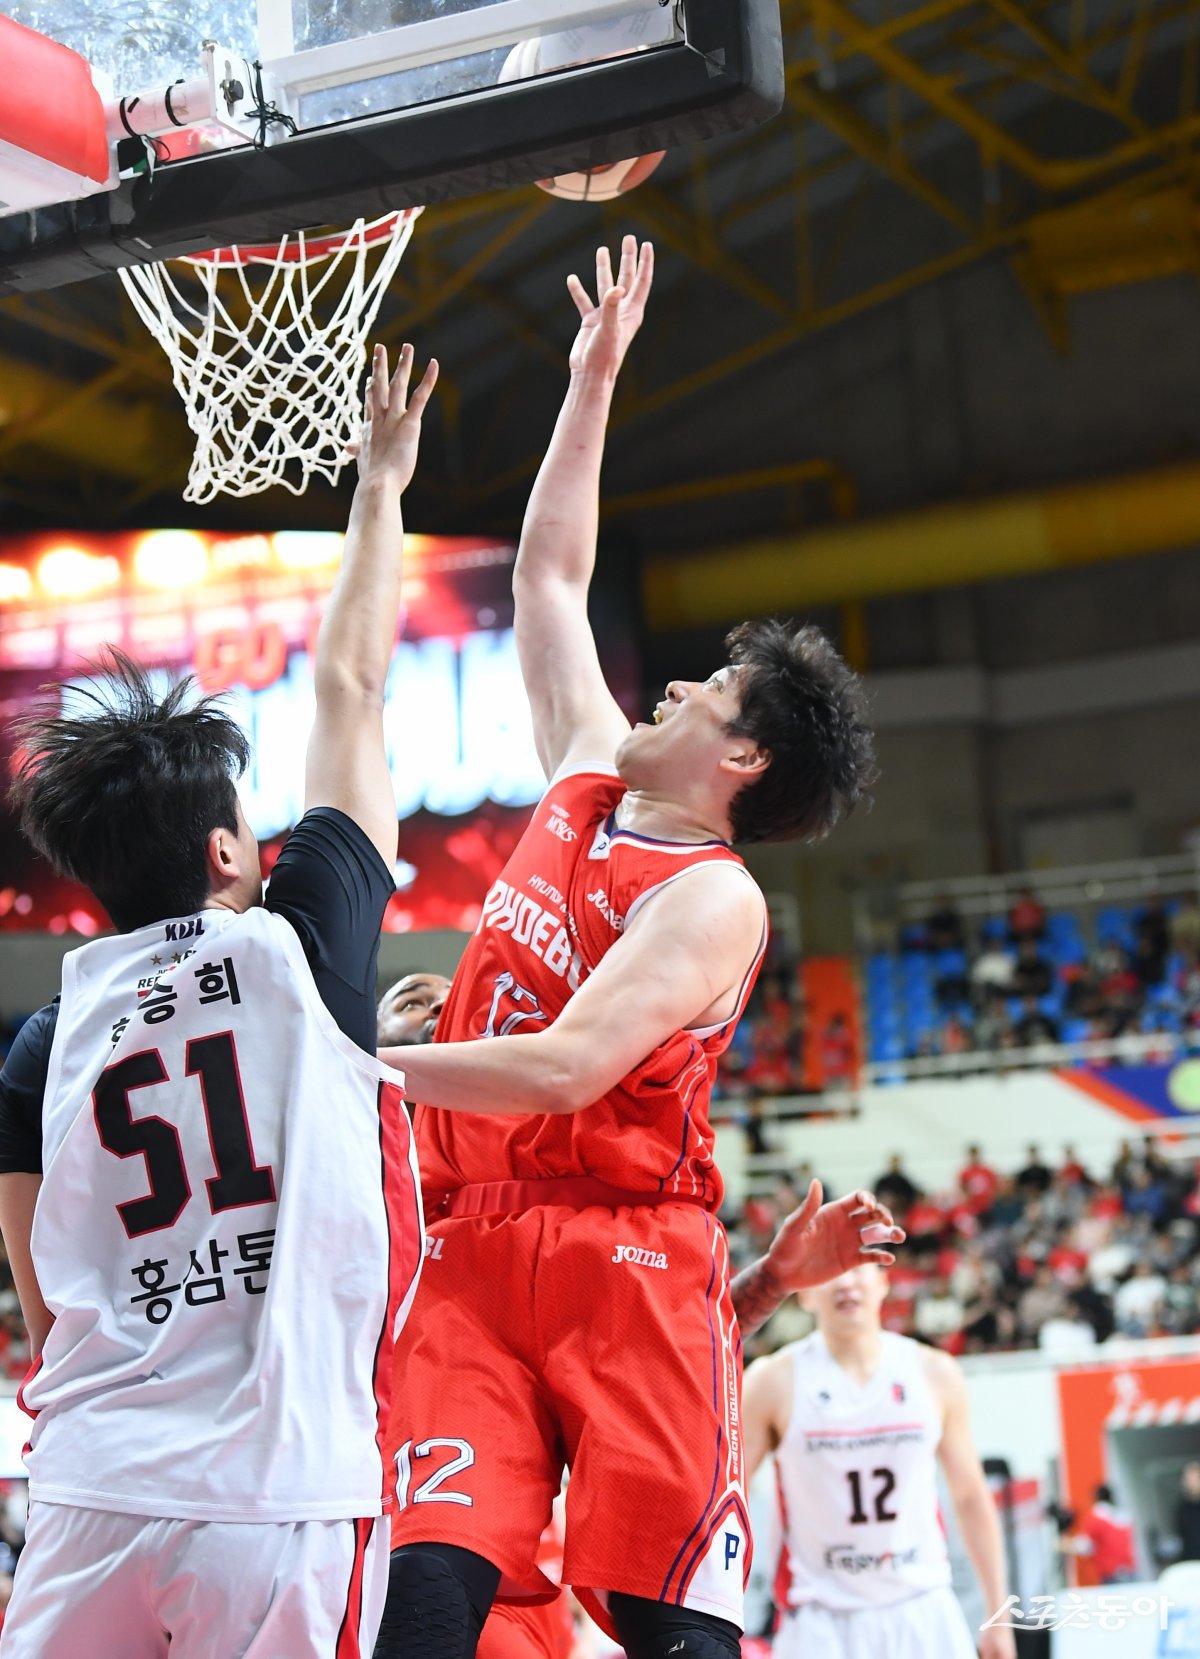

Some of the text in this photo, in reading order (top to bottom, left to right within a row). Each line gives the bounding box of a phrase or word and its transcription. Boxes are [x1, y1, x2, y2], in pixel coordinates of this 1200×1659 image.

[165, 917, 205, 942] KBL
[478, 970, 548, 1038] 12
[91, 1029, 278, 1240] 51
[130, 1228, 276, 1325] 홍삼톤
[611, 1244, 668, 1269] Joma
[392, 1436, 475, 1512] 12
[845, 1466, 897, 1526] 12
[724, 1531, 740, 1570] P
